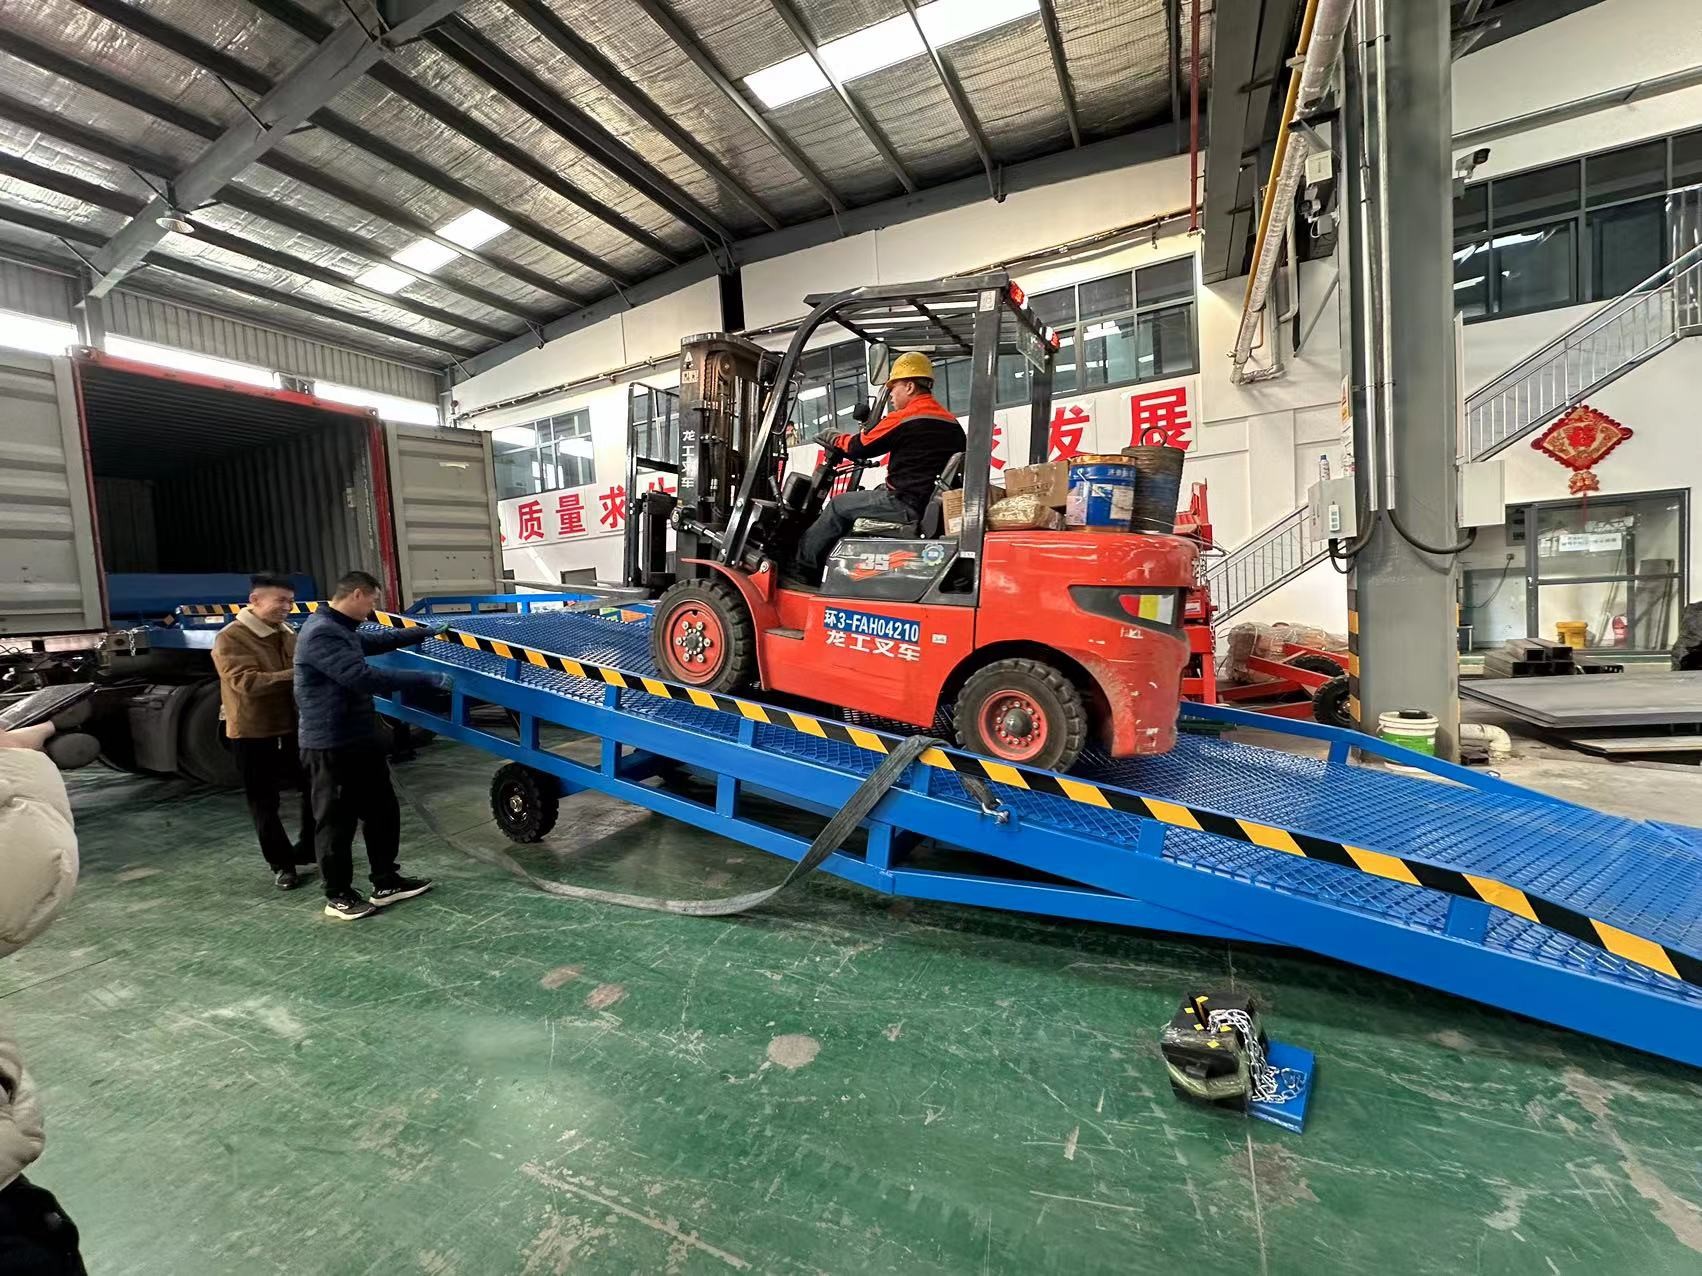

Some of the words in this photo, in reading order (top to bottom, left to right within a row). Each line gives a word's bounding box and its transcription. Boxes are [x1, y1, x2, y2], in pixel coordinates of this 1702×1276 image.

[681, 430, 696, 488] 龙工叉车
[824, 609, 919, 642] 环3-FAH04210
[825, 629, 921, 662] 龙工叉车
